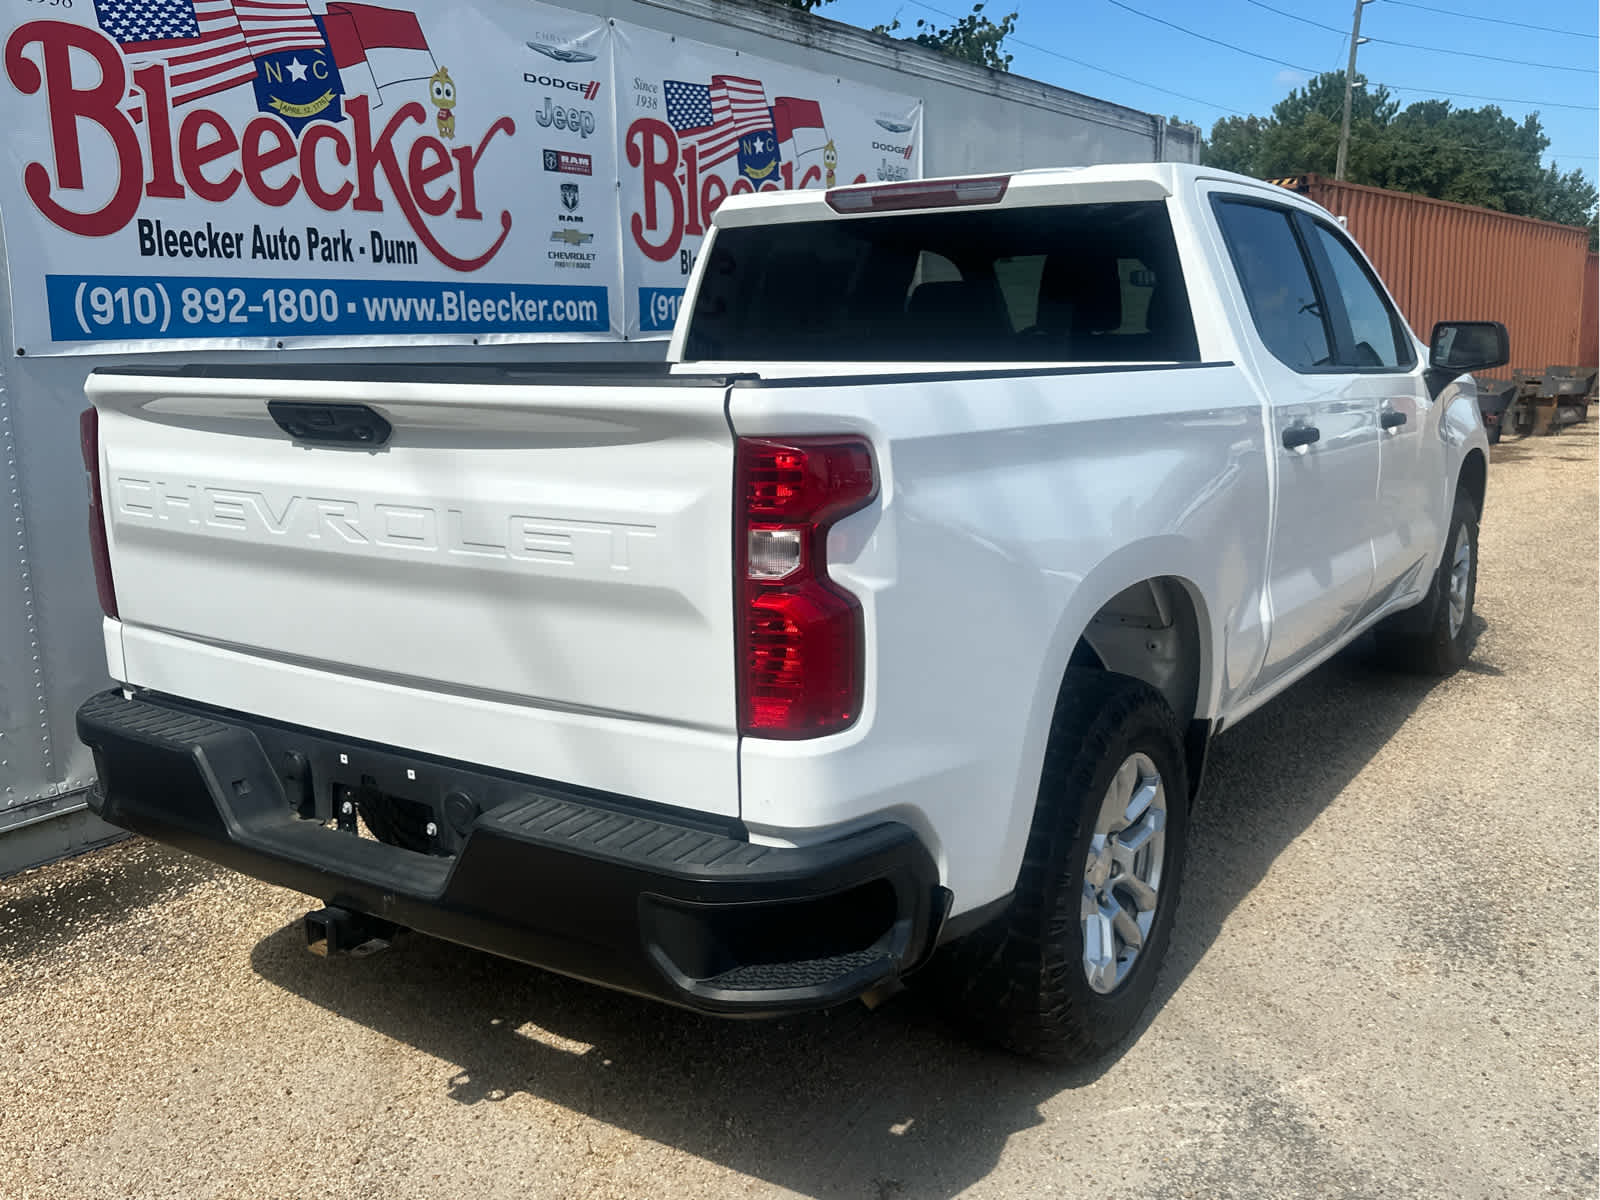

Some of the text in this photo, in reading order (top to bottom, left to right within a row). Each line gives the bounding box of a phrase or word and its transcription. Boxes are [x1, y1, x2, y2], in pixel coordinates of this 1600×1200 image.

[264, 60, 329, 84] N C
[523, 73, 589, 93] DODGE
[633, 77, 659, 94] Since
[635, 94, 659, 110] 1938
[535, 96, 596, 139] Jeep
[4, 20, 517, 273] Bleecker
[560, 154, 590, 167] RAM
[558, 214, 584, 223] RAM
[137, 218, 418, 265] Bleecker Auto Park Dunn
[547, 251, 596, 262] CHEVROLET
[74, 282, 598, 333] (910) 892-1800 www.Bleecker.com
[117, 477, 658, 572] CHEVROLET
